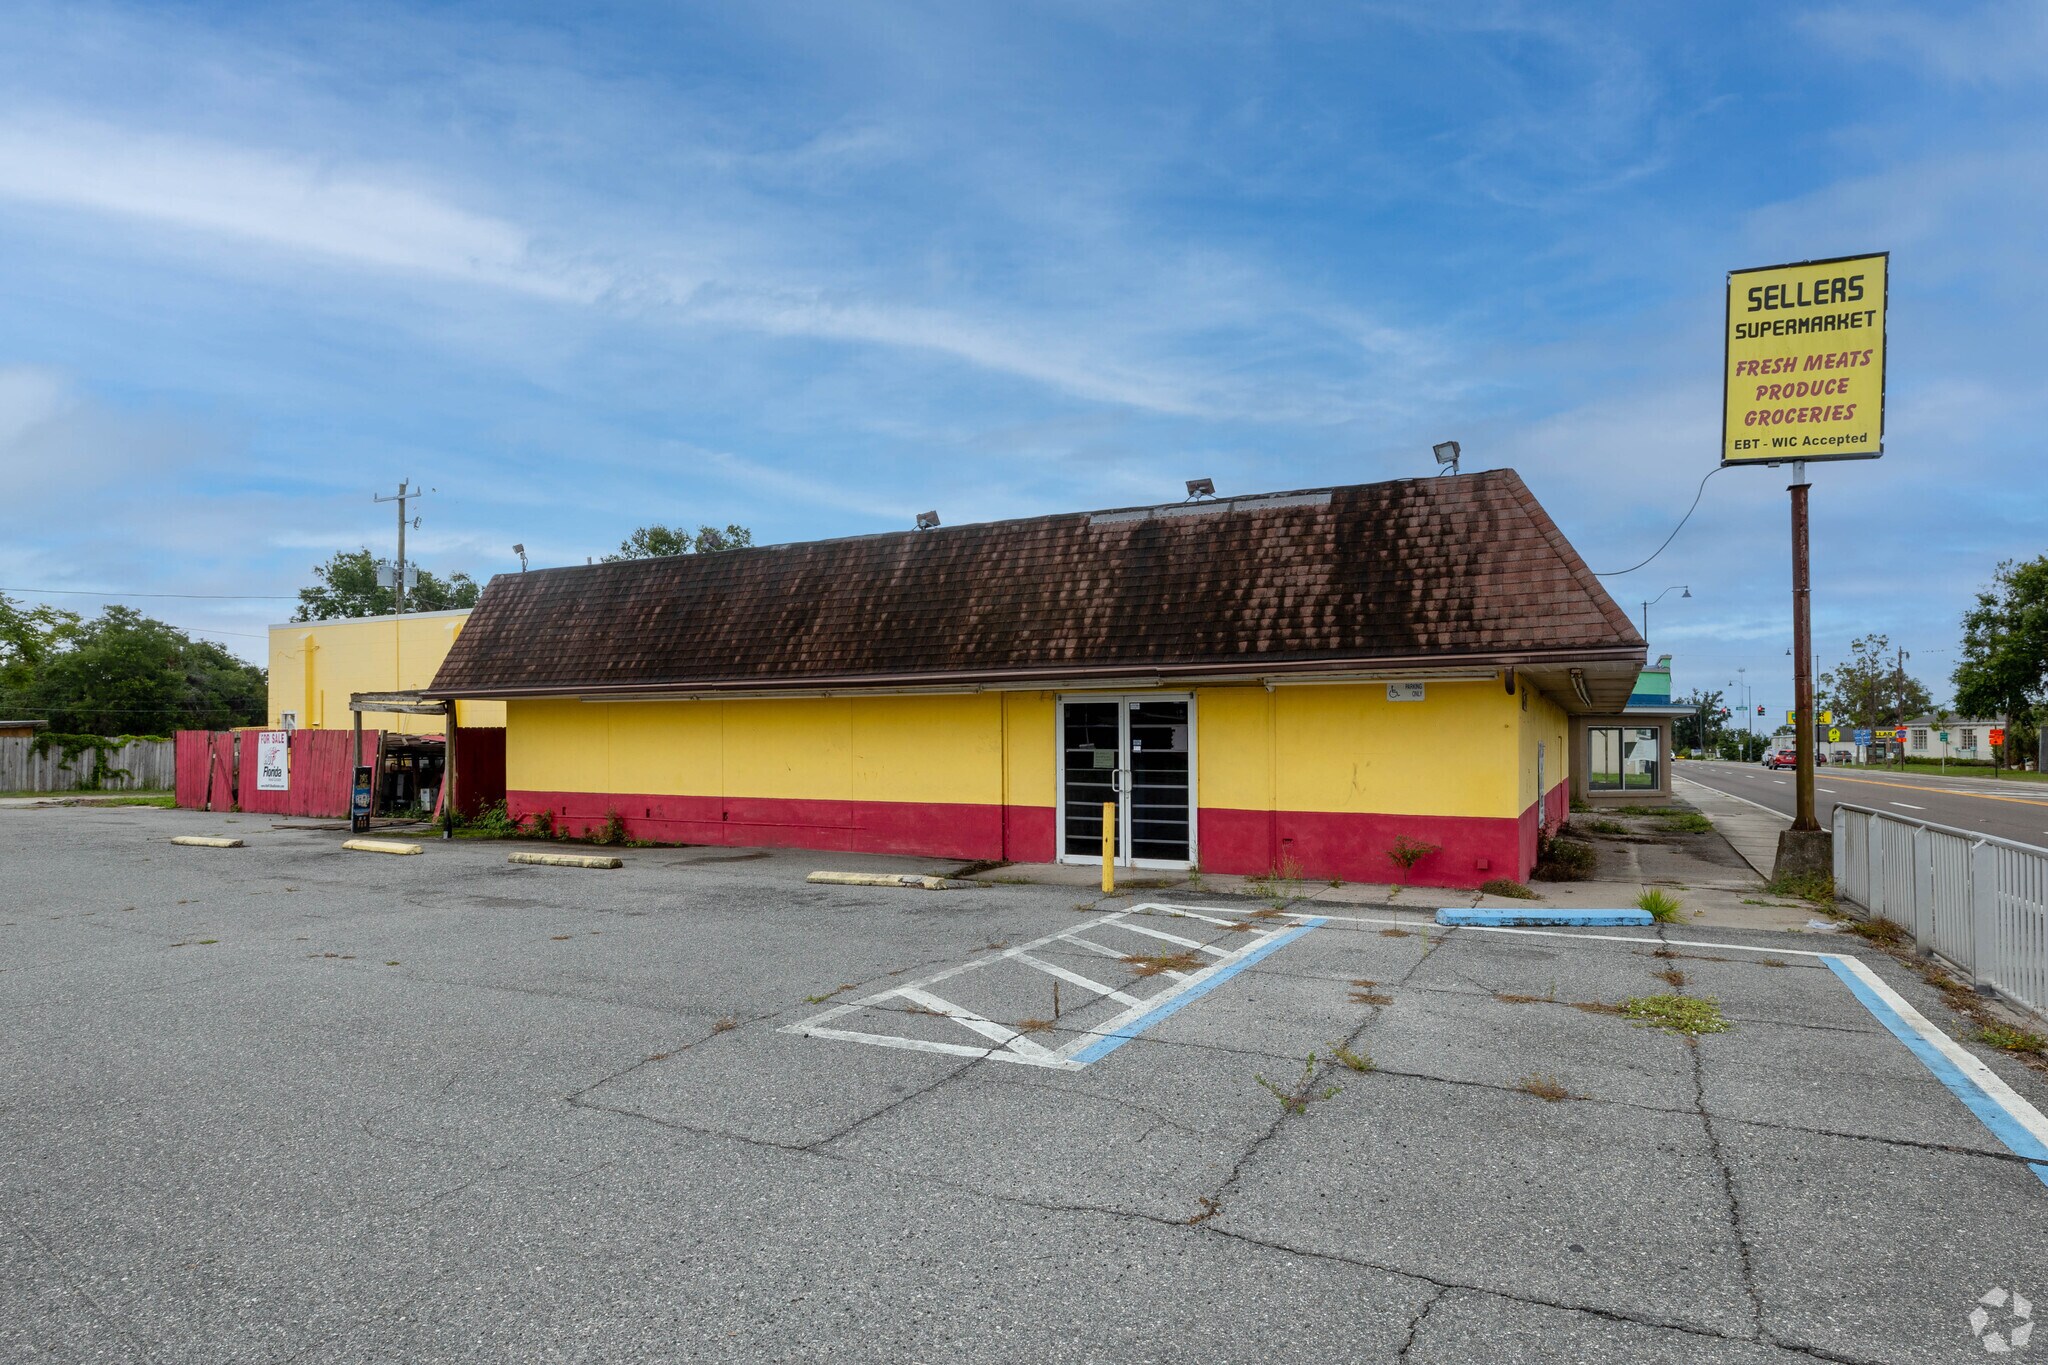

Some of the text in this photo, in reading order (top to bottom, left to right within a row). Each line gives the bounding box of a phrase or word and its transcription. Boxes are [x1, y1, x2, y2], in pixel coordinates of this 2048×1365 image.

[1747, 275, 1865, 312] SELLERS
[1735, 310, 1877, 339] SUPERMARKET
[1735, 349, 1874, 377] FRESH MEATS
[1755, 378, 1850, 401] PRODUCE
[1744, 404, 1857, 427] GROCERIES
[1734, 439, 1760, 450] EBT
[1772, 436, 1798, 448] WIC
[1802, 433, 1868, 448] Accepted
[260, 733, 285, 744] FOR SALE
[262, 765, 282, 778] Florida
